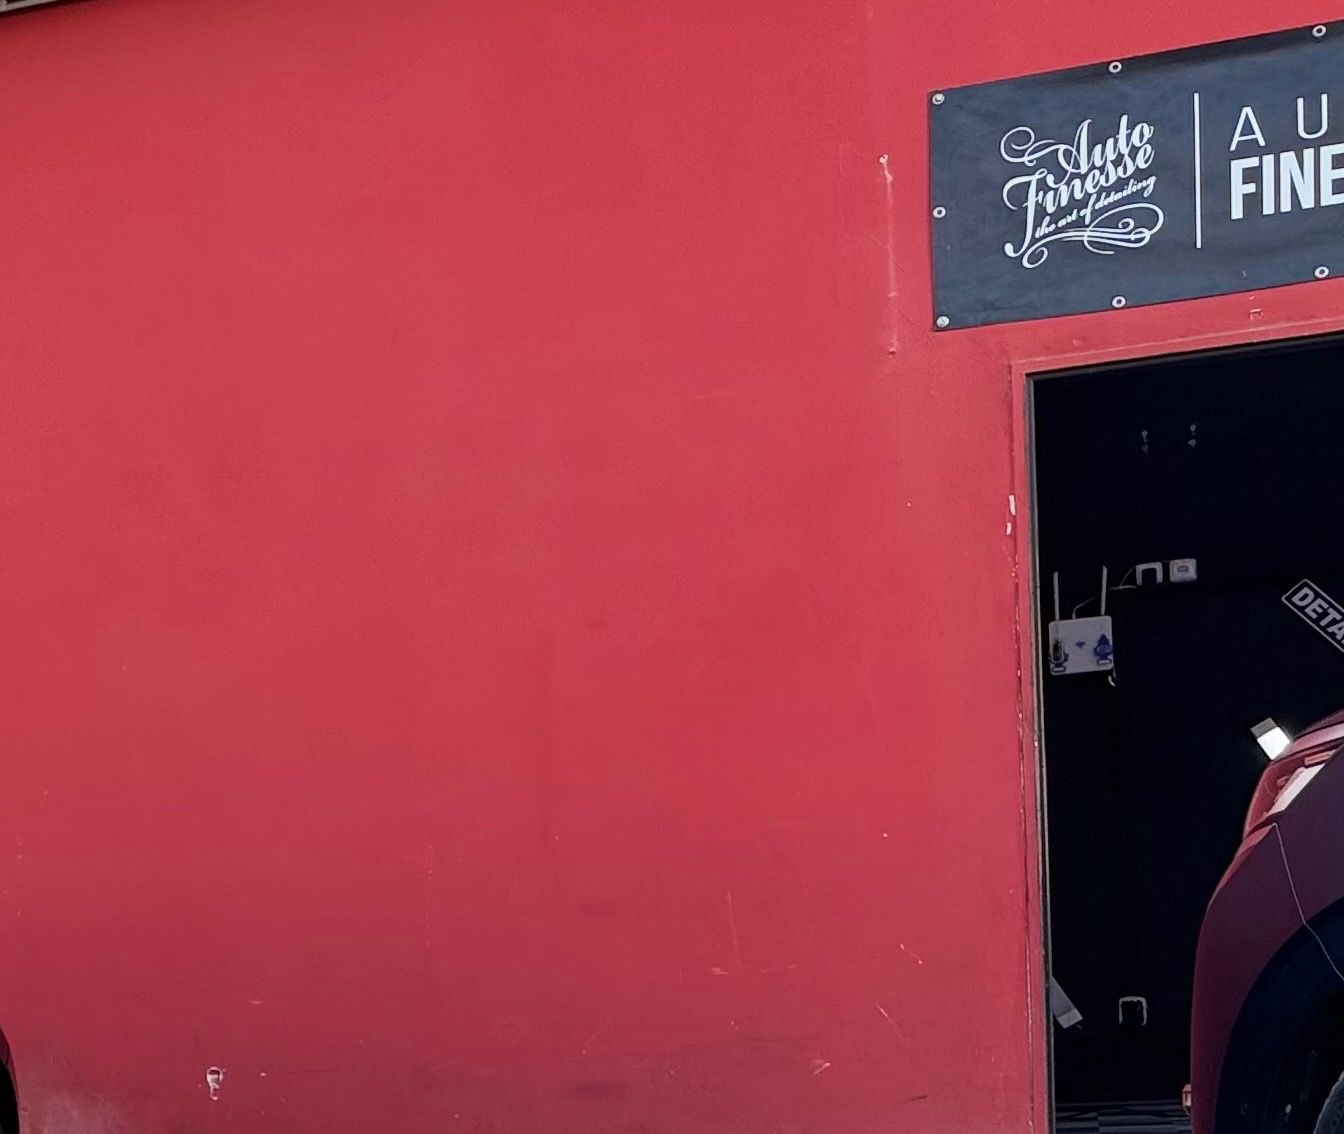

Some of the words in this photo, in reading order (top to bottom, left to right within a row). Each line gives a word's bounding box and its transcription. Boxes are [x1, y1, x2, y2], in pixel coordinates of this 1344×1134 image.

[1020, 114, 1155, 188] Auto
[1230, 142, 1344, 220] FINE
[1003, 144, 1155, 257] Finesse
[1035, 215, 1056, 238] the
[1057, 209, 1078, 228] art
[1079, 194, 1097, 225] of
[1095, 176, 1157, 207] detailing
[1291, 587, 1344, 645] DETA
